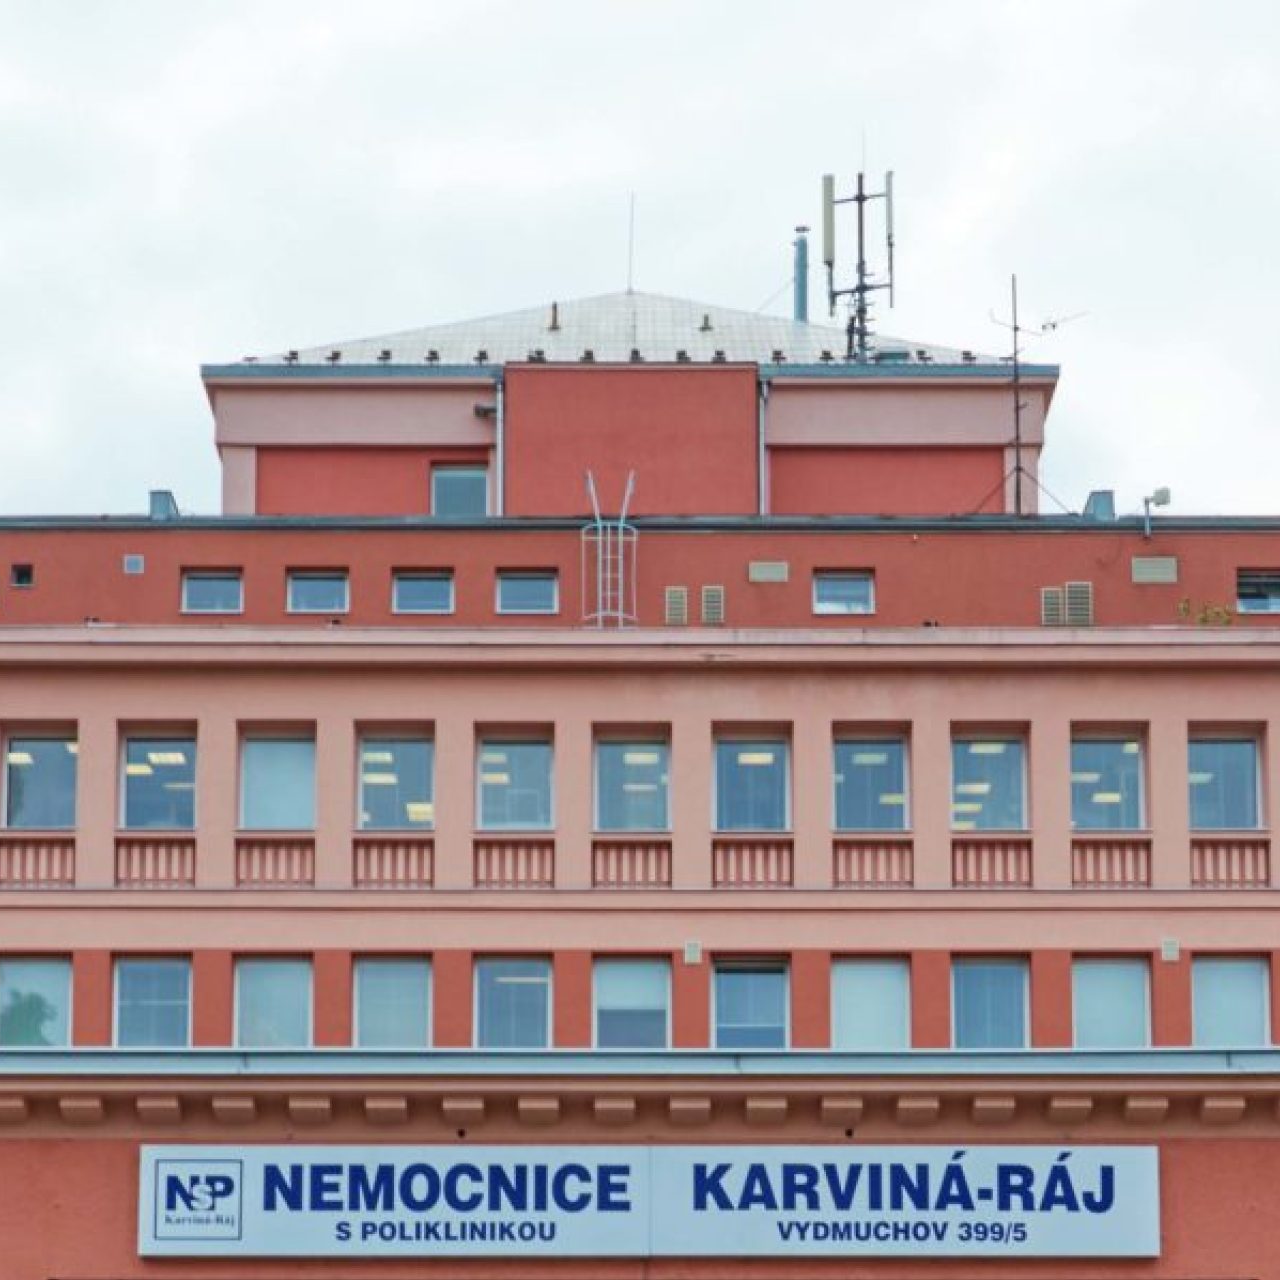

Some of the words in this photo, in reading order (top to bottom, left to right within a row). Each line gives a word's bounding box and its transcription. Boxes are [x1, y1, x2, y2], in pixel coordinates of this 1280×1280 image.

[263, 1163, 631, 1213] NEMOCNICE
[693, 1150, 1114, 1214] KARVINÁ-RÁJ
[335, 1220, 353, 1242] S
[361, 1220, 557, 1242] POLIKLINIKOU
[776, 1220, 950, 1242] VYDMUCHOV
[958, 1220, 1029, 1243] 399/5
